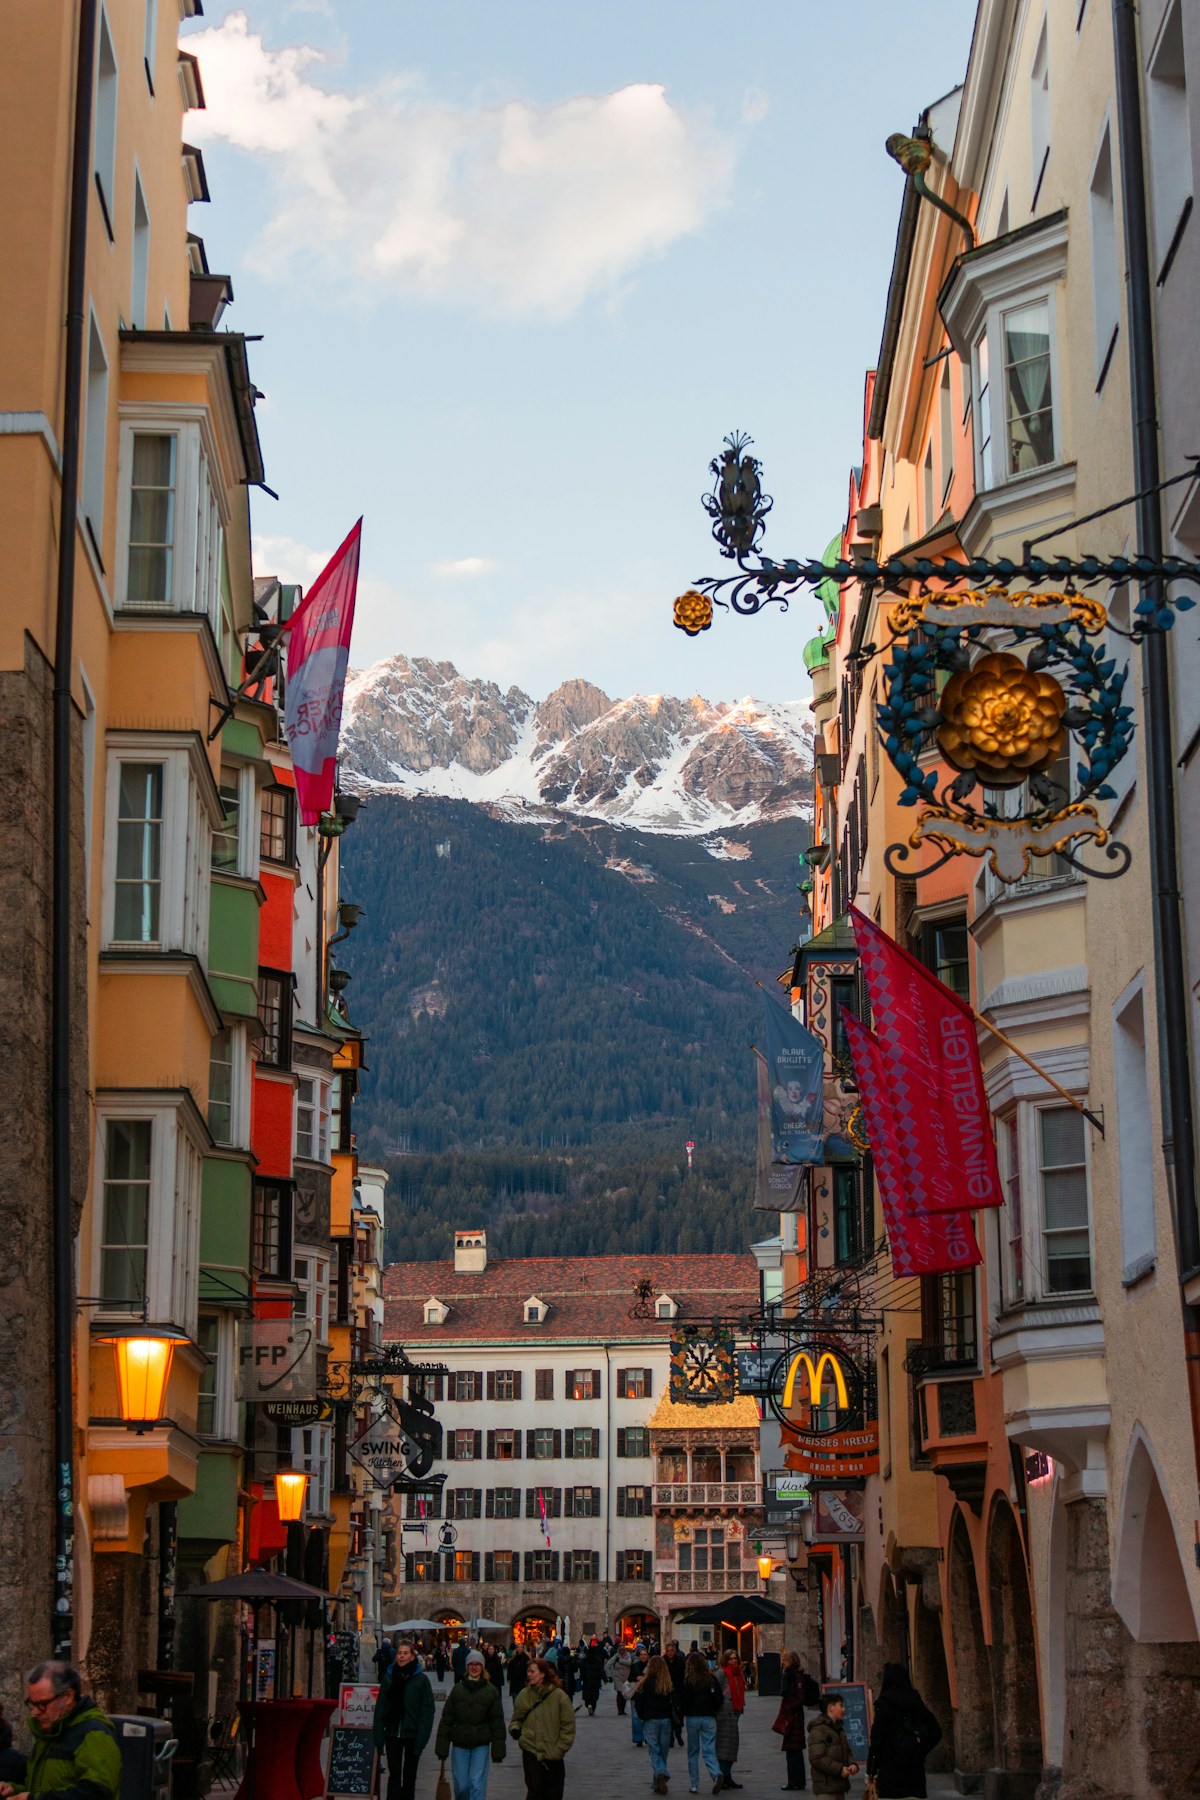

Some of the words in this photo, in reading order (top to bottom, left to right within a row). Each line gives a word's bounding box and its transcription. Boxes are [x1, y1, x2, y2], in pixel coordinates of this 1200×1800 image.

[777, 1056, 812, 1064] BRIGITTE
[930, 1108, 960, 1174] years
[931, 1176, 953, 1203] 40
[240, 1345, 287, 1366] FFP
[267, 1403, 319, 1415] WEINHAUS
[798, 1435, 839, 1447] WEISSES
[842, 1434, 875, 1446] KREUZ
[361, 1441, 410, 1456] SWING
[367, 1457, 405, 1470] Kitchen
[809, 1462, 836, 1472] ROOMS
[848, 1463, 864, 1471] BAR
[828, 1495, 855, 1529] 1465
